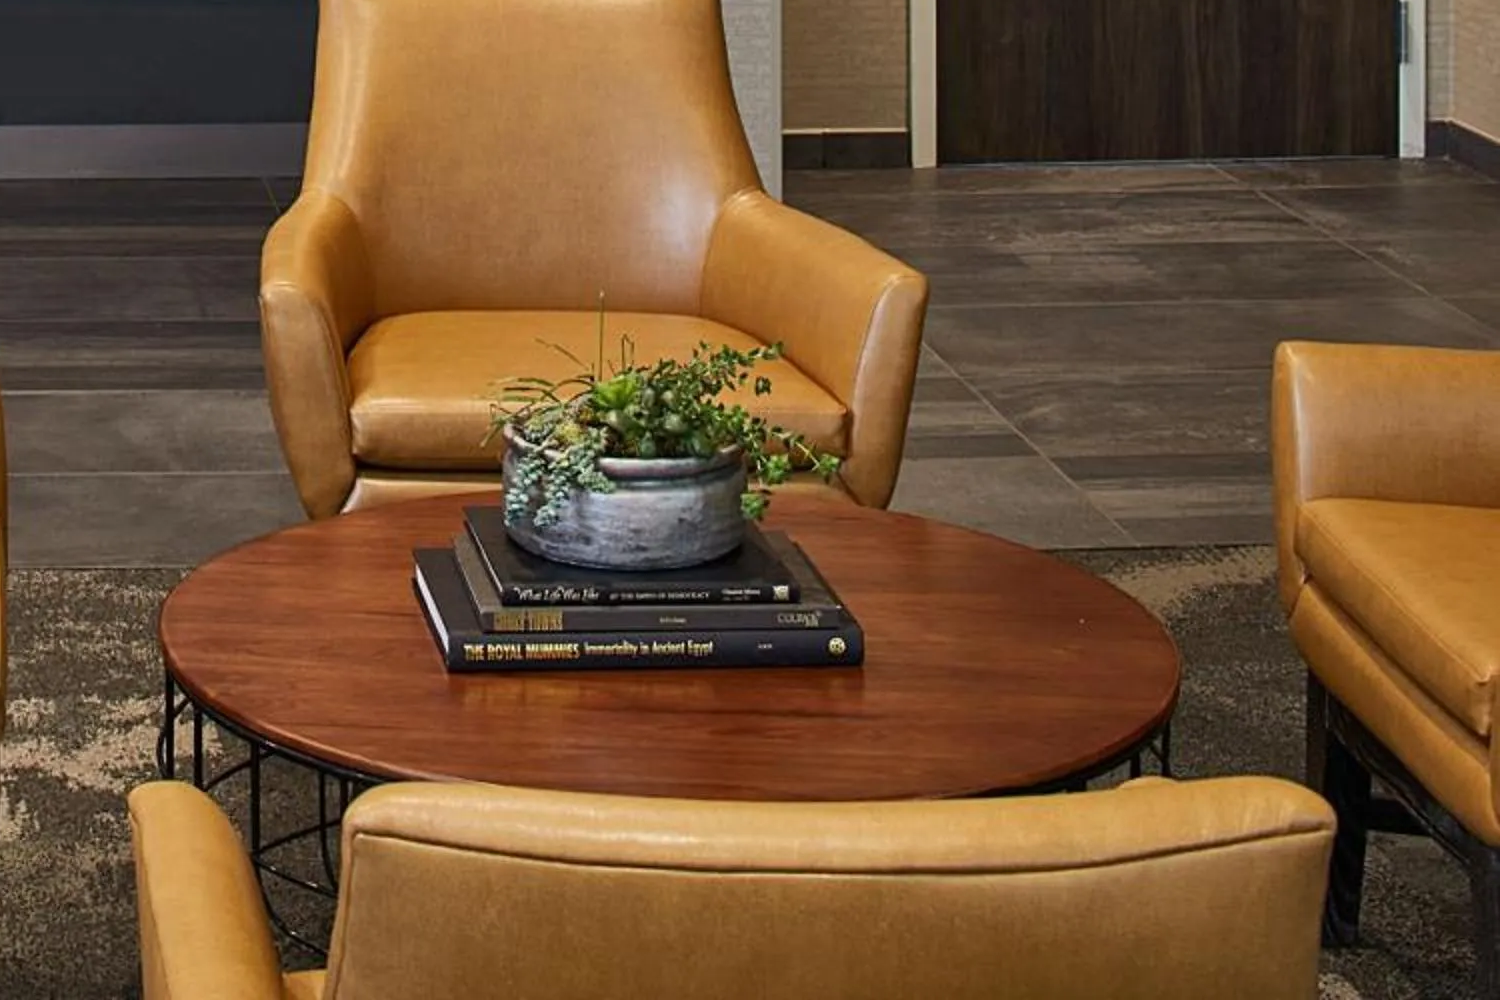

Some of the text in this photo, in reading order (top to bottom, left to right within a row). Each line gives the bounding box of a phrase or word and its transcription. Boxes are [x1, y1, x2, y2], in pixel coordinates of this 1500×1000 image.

[463, 643, 485, 661] THE
[487, 643, 523, 660] ROYAL
[525, 642, 580, 660] MUMMIES
[640, 641, 650, 654] in
[652, 640, 685, 655] Ancient
[687, 639, 713, 657] Egypt
